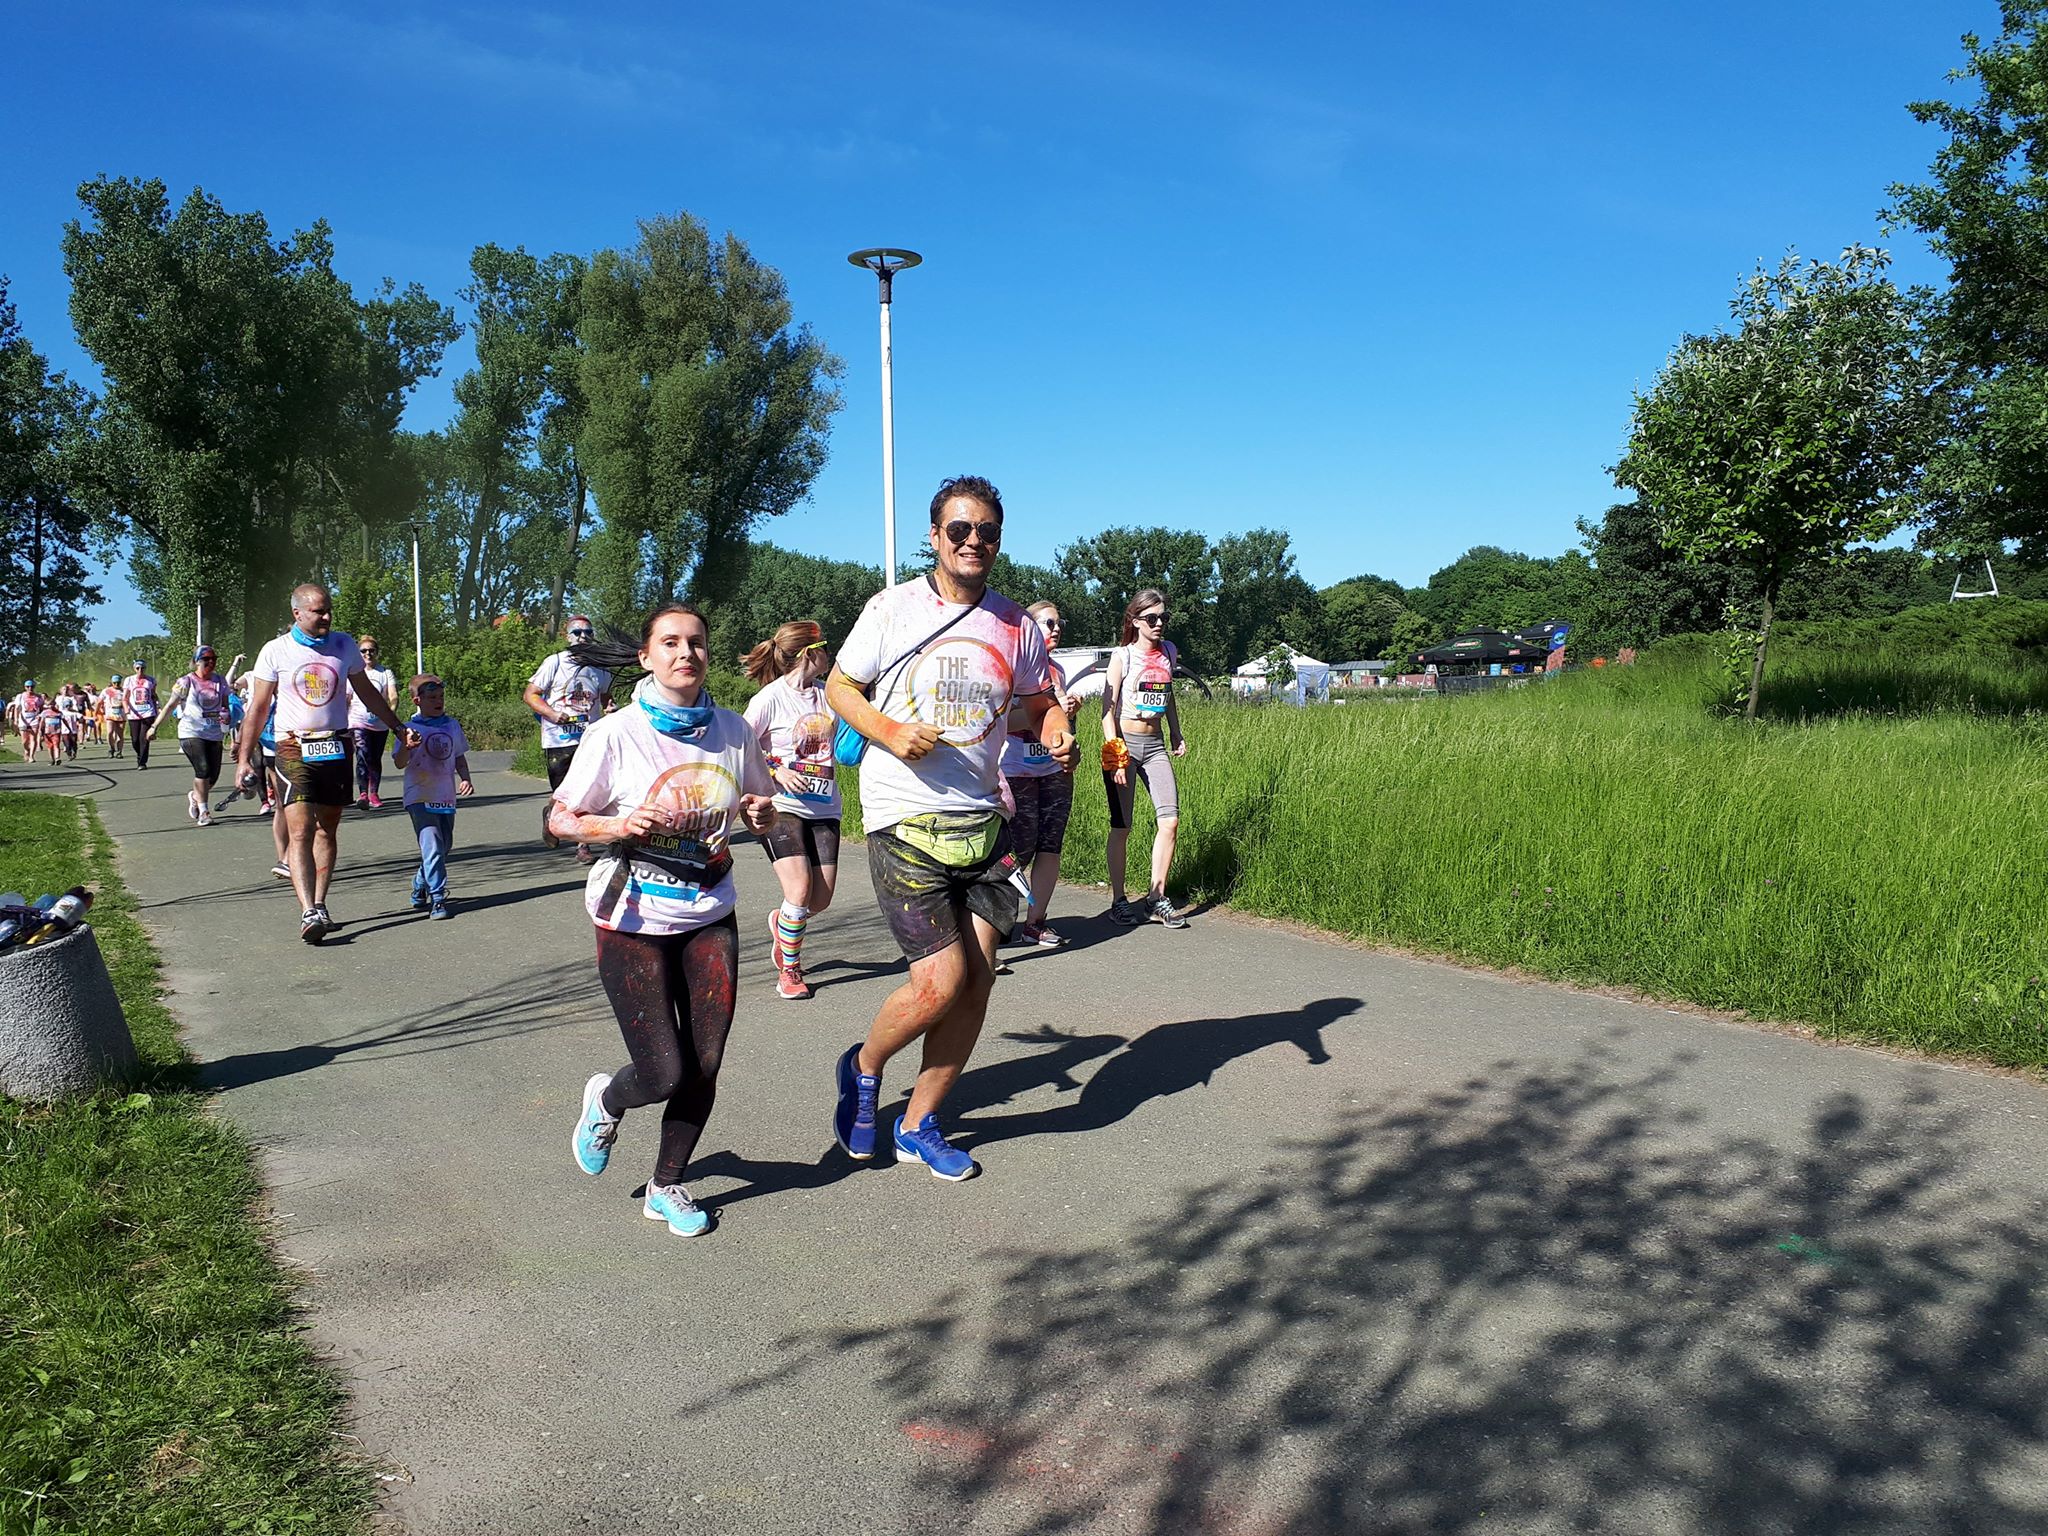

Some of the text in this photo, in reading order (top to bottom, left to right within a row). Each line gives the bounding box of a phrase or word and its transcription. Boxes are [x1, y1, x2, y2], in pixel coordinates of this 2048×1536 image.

[936, 657, 969, 680] THE
[935, 680, 993, 707] COLOR
[933, 703, 968, 727] RUN
[308, 741, 341, 756] 09626
[671, 784, 708, 809] THE
[650, 834, 680, 850] COLOR
[680, 840, 698, 852] RUN
